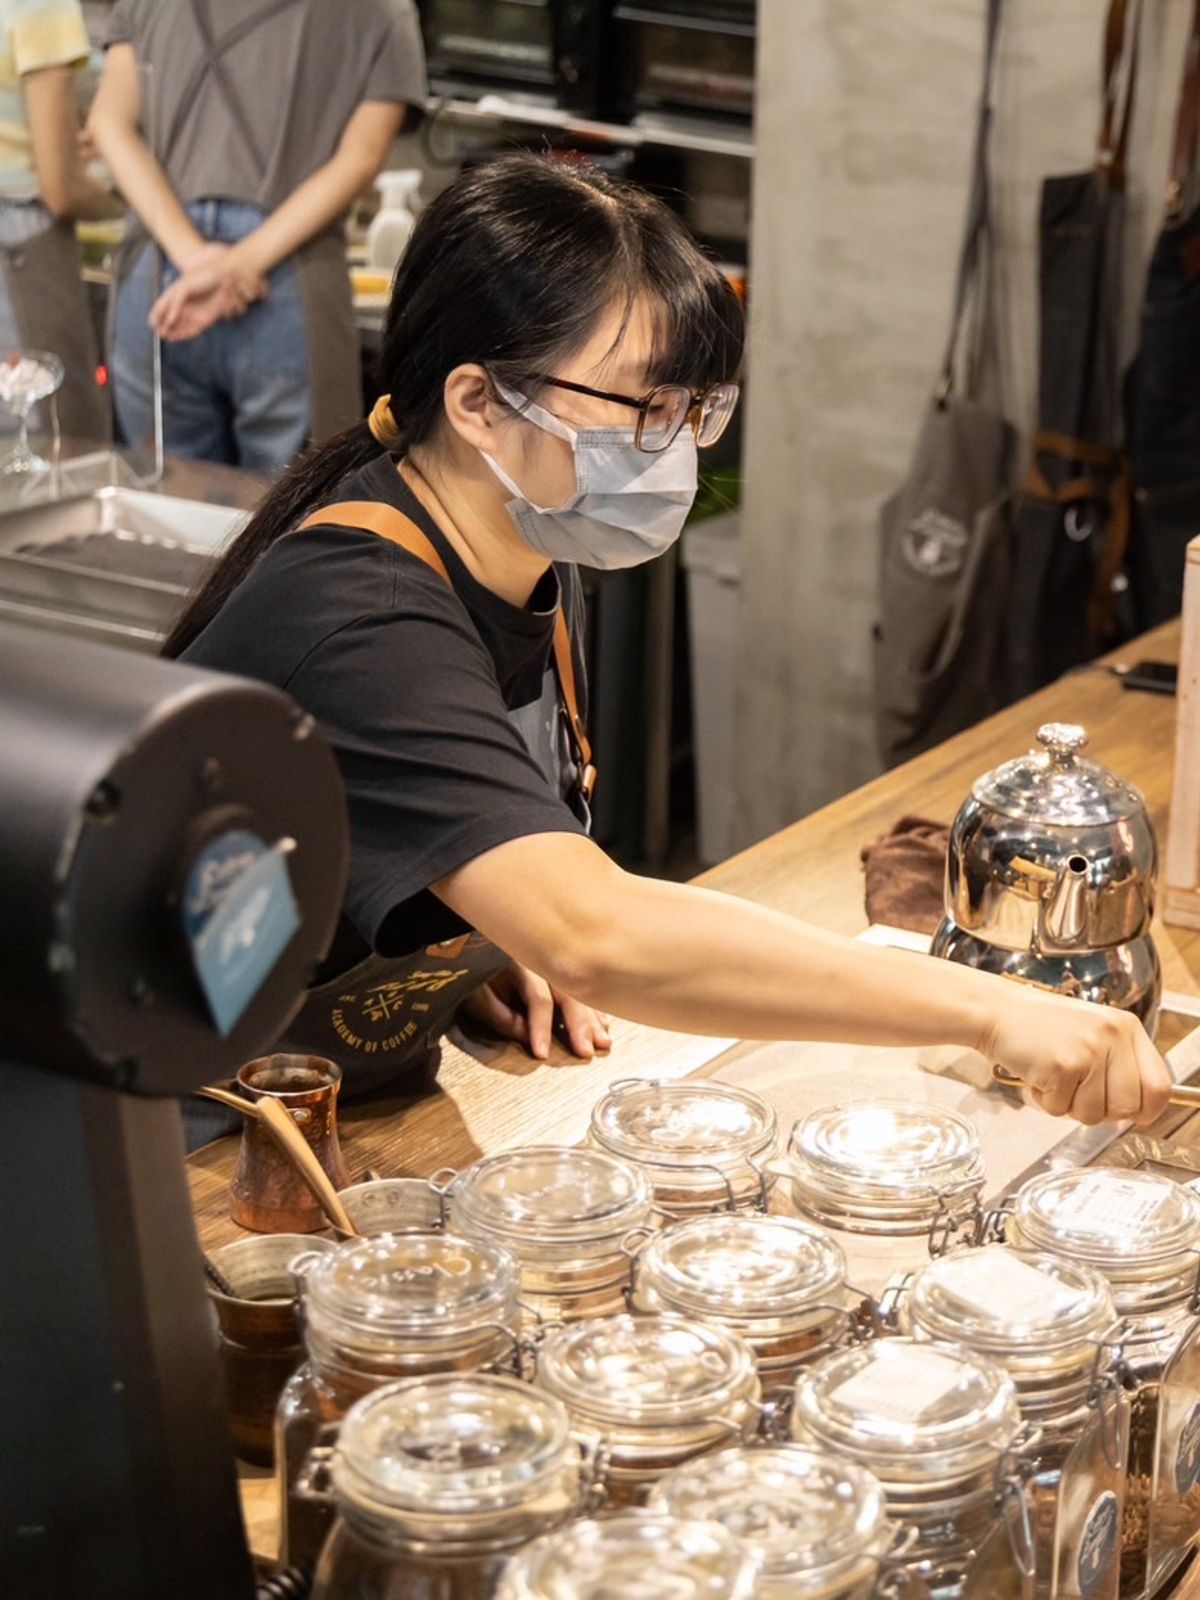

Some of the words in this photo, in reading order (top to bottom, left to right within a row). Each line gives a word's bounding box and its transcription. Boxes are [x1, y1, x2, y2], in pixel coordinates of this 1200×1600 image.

[332, 1008, 363, 1049] ACADEMY
[364, 1040, 378, 1053] OF
[382, 1020, 418, 1051] COFFEE
